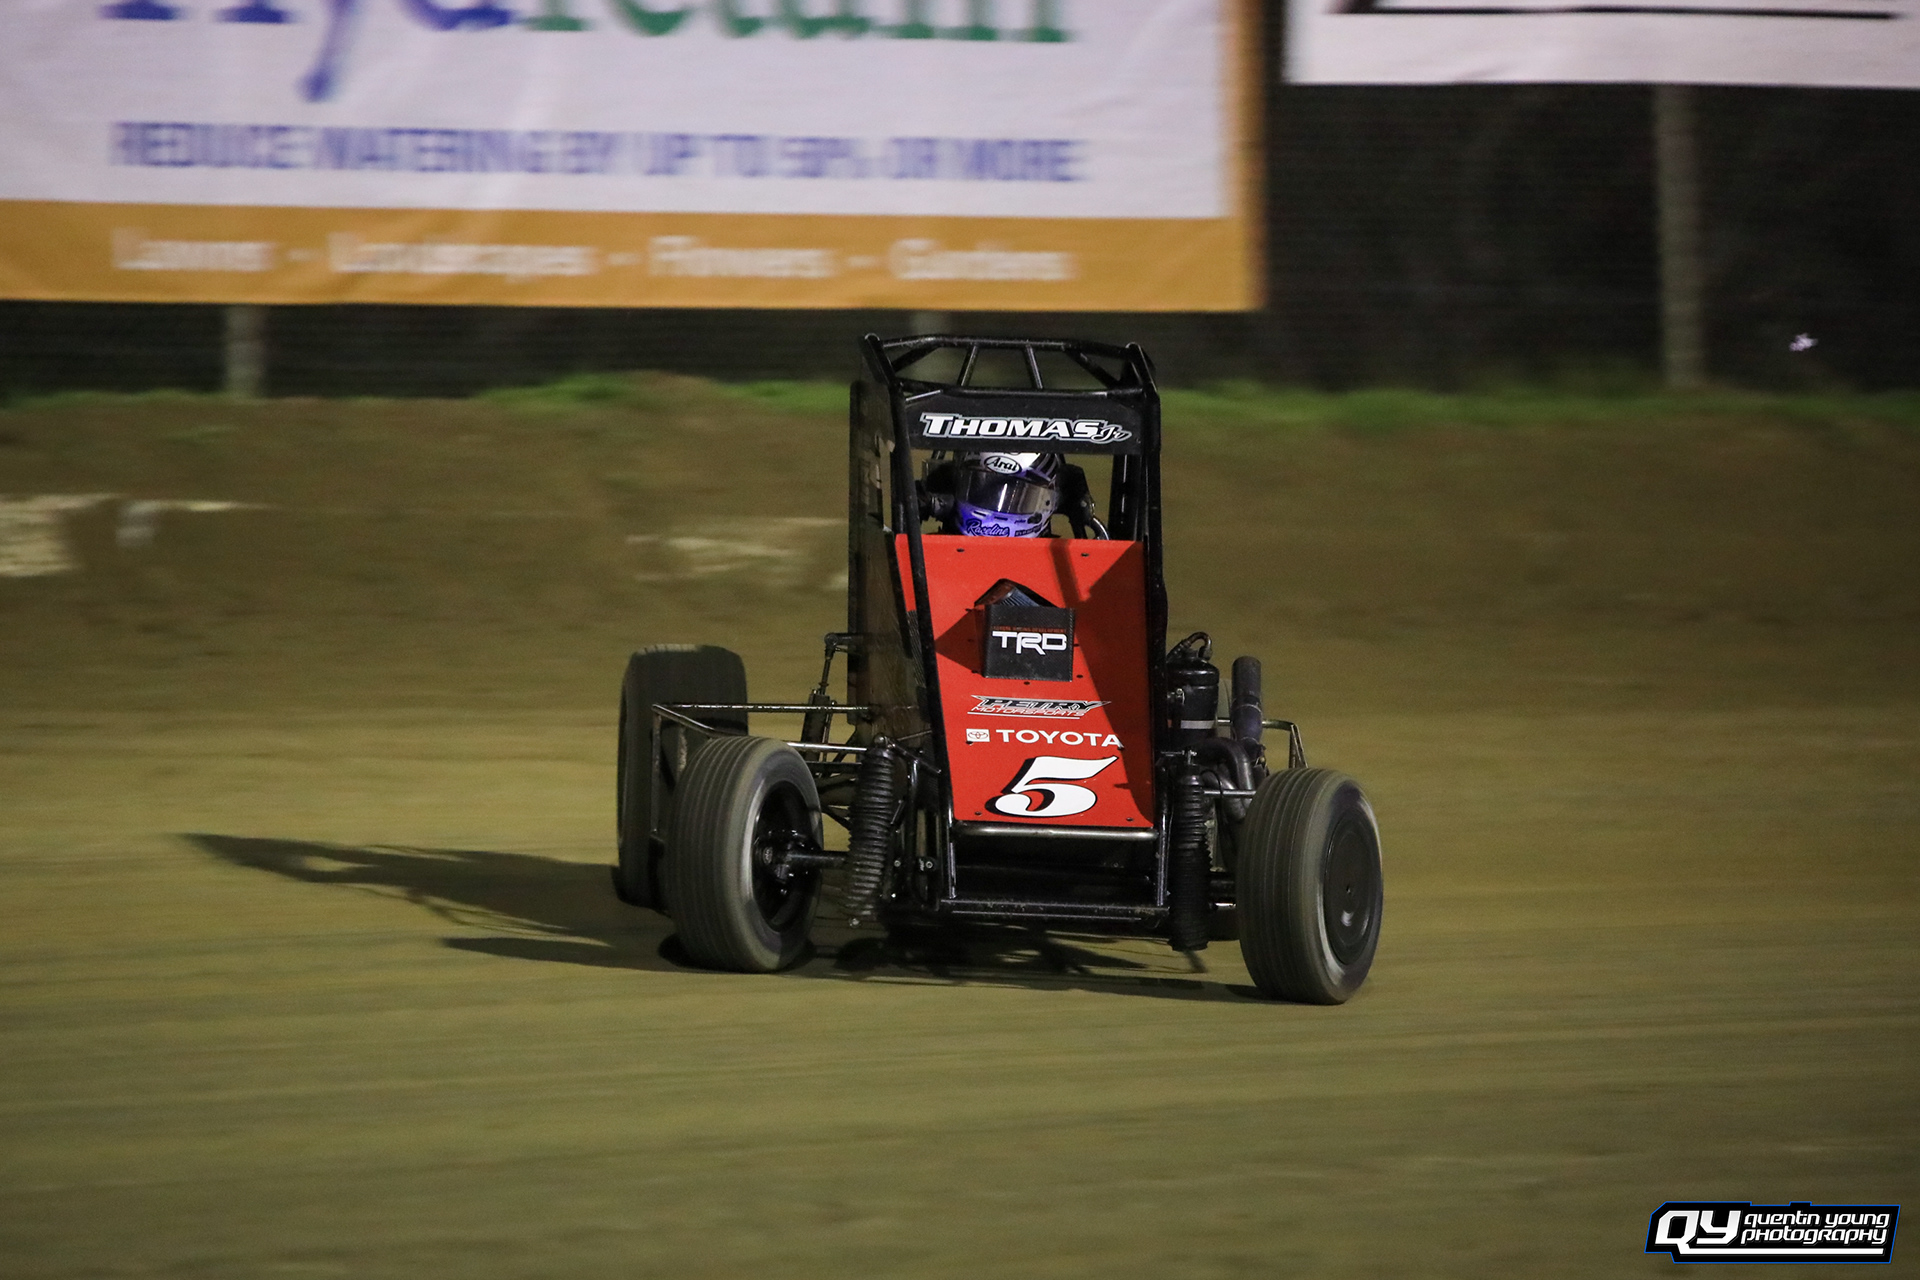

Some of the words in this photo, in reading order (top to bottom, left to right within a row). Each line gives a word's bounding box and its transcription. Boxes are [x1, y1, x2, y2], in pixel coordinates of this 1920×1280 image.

[112, 121, 308, 169] REDUCE
[948, 138, 1090, 182] MORE
[921, 413, 1103, 441] THOMAS
[986, 457, 1019, 472] Arai
[992, 630, 1068, 656] TRD
[970, 705, 1087, 717] MOTORSPORTS
[995, 729, 1125, 749] TOYOTA
[984, 755, 1119, 818] 5
